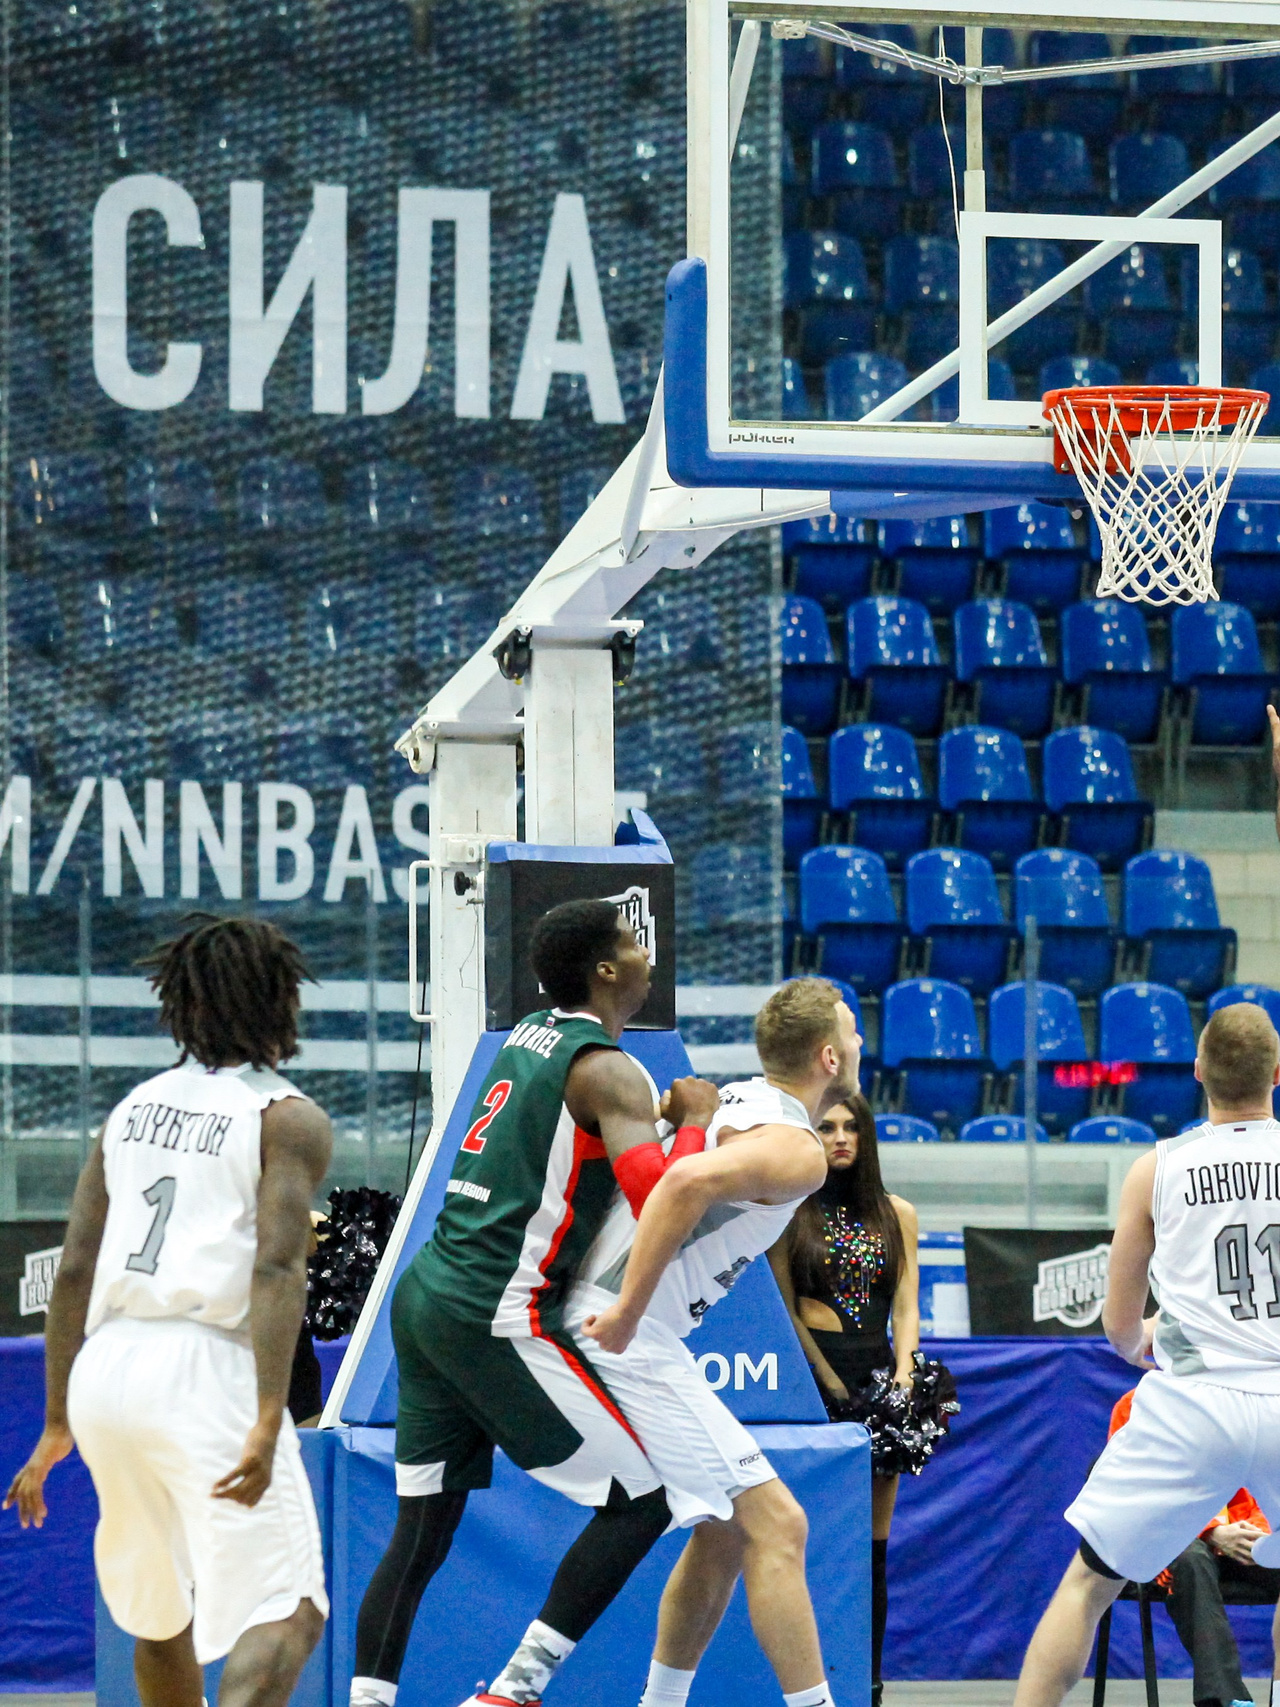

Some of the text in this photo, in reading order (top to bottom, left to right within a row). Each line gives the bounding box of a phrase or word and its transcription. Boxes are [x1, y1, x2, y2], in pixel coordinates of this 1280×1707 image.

[92, 174, 626, 424] СИЛА
[123, 1102, 233, 1157] BOYNTON
[460, 1079, 513, 1154] 2
[125, 1175, 176, 1277] 1
[693, 1352, 778, 1391] OM
